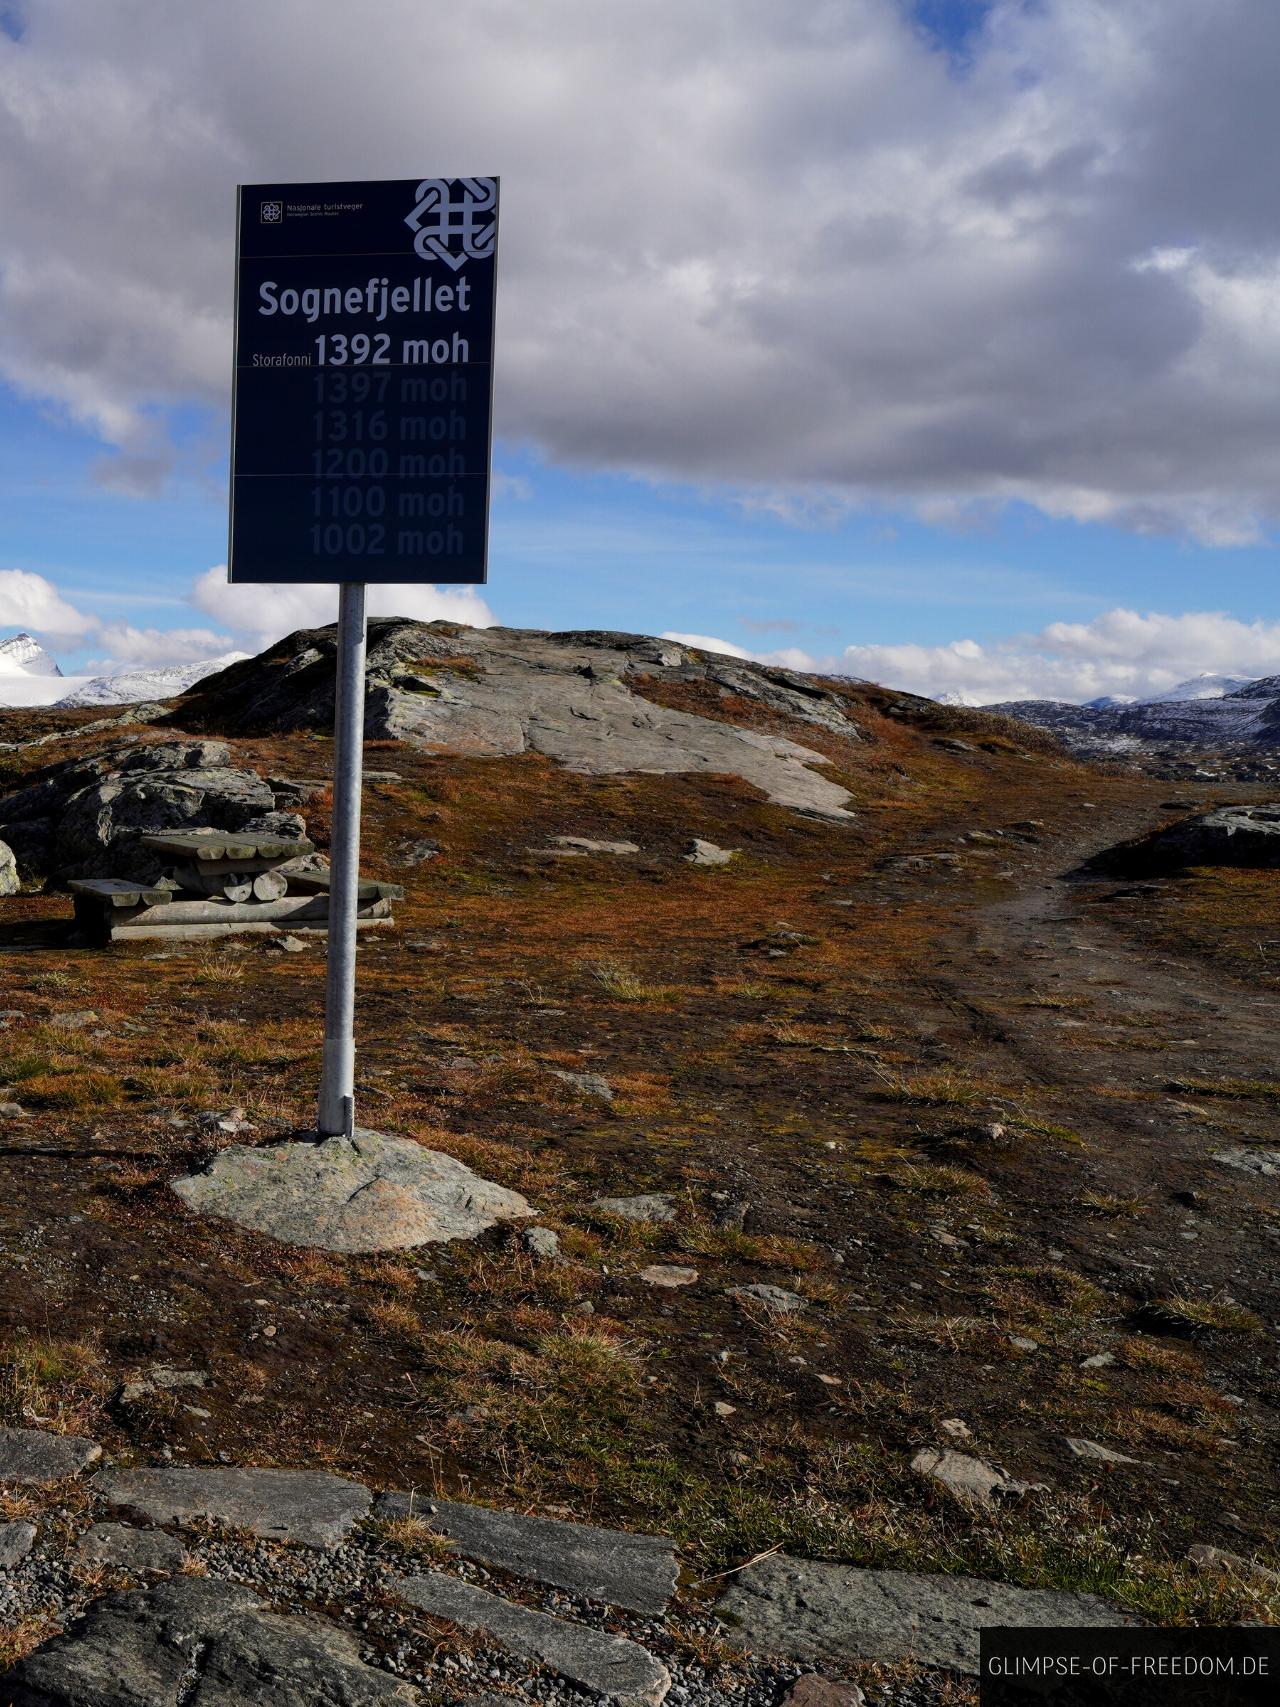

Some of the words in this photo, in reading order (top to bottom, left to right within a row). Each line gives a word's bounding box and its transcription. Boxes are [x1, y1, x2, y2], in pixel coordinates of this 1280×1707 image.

[287, 203, 321, 212] Nasjonale
[324, 202, 363, 211] turistveger
[258, 277, 471, 323] Sognefjellet
[252, 353, 312, 367] Storafonni
[314, 333, 391, 365] 1392
[402, 331, 469, 364] moh
[313, 372, 391, 403] 1397
[400, 371, 467, 402] moh
[312, 410, 388, 441] 1316
[400, 409, 466, 440] moh
[312, 448, 389, 479] 1200
[399, 447, 465, 478] moh
[311, 486, 385, 517] 1100
[398, 485, 464, 516] moh
[310, 524, 385, 555] 1002
[397, 523, 463, 554] moh
